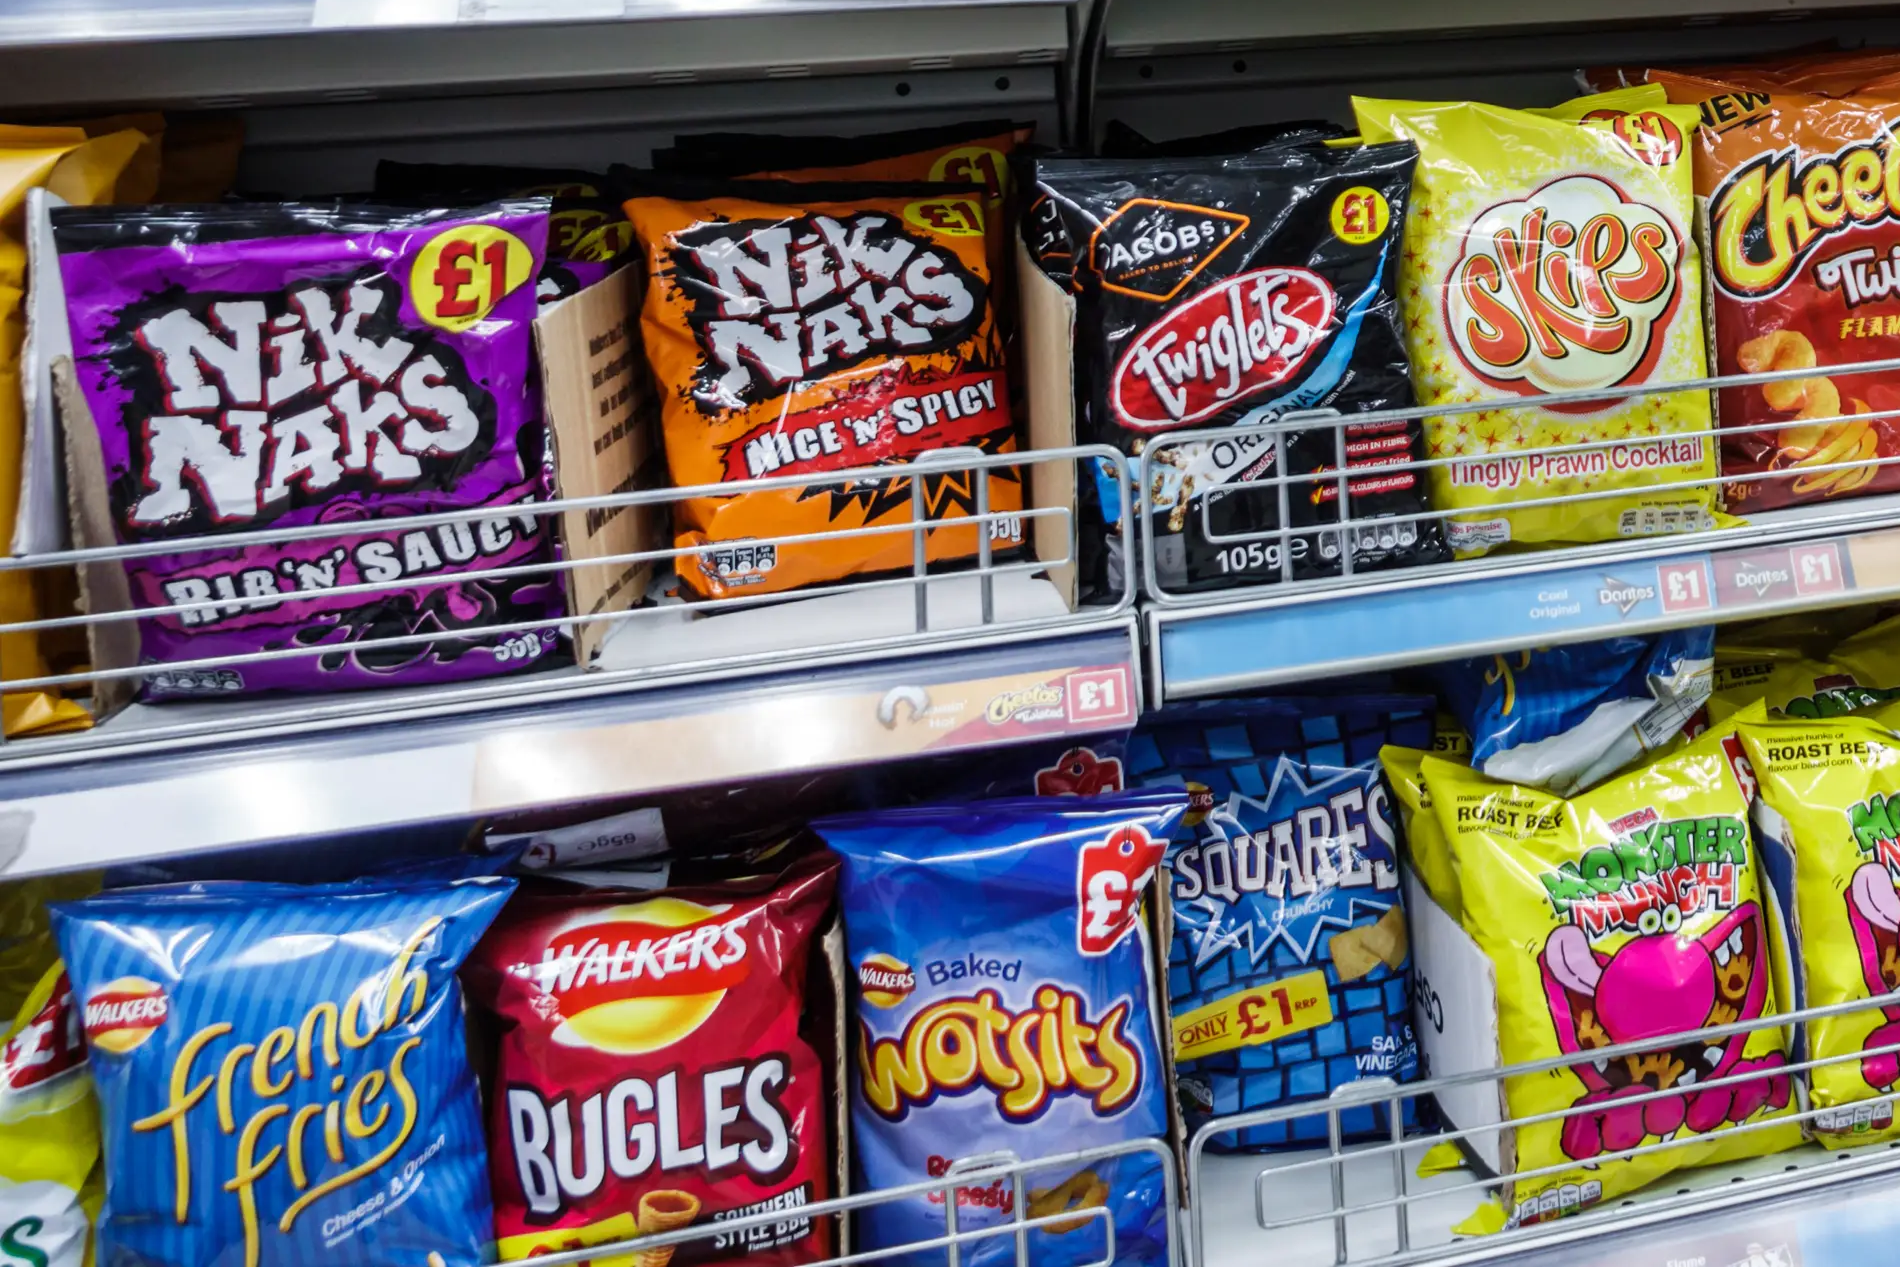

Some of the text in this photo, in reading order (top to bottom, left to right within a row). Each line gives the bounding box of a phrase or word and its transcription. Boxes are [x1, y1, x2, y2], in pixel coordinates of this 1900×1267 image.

[1696, 91, 1772, 130] NEW
[1626, 111, 1676, 158] £1
[922, 202, 978, 231] £1
[1341, 193, 1378, 235] £1
[434, 240, 510, 318] £1
[698, 216, 914, 317] NiK
[1464, 207, 1668, 366] Skips
[138, 282, 415, 412] NiK
[690, 255, 975, 410] NAKS
[126, 354, 481, 525] NAKS
[745, 377, 998, 478] NICE SPICY
[1379, 436, 1408, 451] FIBRE
[1450, 436, 1703, 489] Tingly Prawn Cocktail
[165, 496, 543, 626] RIB SAUCY
[1215, 540, 1283, 575] 105g
[1736, 566, 1789, 588] Doritos
[1801, 548, 1834, 582] £1
[1600, 583, 1655, 605] Doritos
[1667, 568, 1701, 602] £1
[1529, 601, 1581, 621] Original
[986, 683, 1063, 724] Cheetos
[1078, 678, 1117, 711] £1
[1767, 743, 1834, 763] ROAST
[1767, 762, 1799, 774] flavour
[1457, 806, 1521, 828] ROAST
[1175, 784, 1400, 907] SQUARES
[1537, 816, 1749, 916] MONSTER
[1570, 862, 1739, 942] MUNCH
[540, 917, 749, 995] WALKERS
[925, 952, 1023, 987] Baked
[858, 967, 915, 988] WALKERS
[84, 994, 168, 1027] WALKERS
[1178, 986, 1318, 1048] ONLY £1 RRP
[507, 1057, 790, 1217] BUGLES
